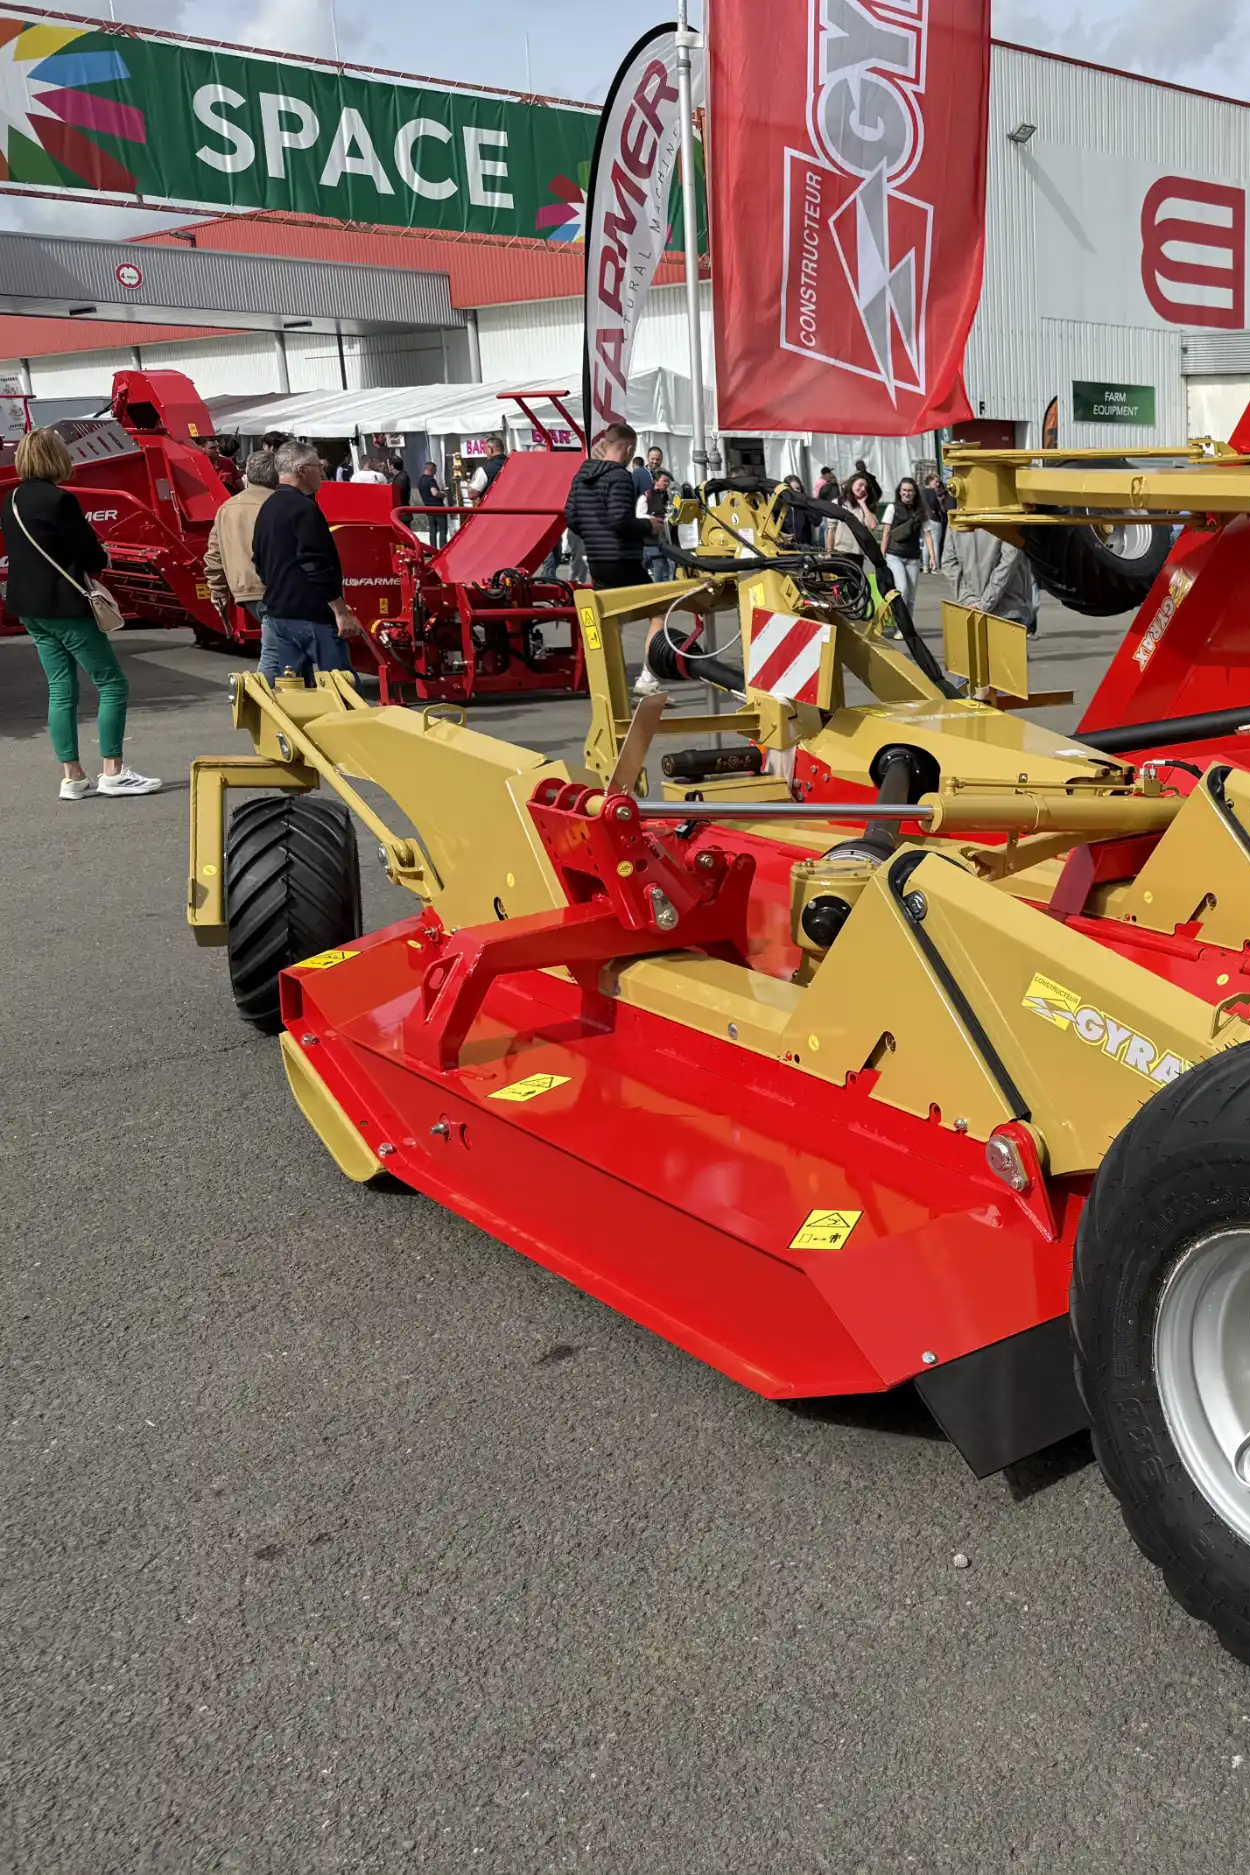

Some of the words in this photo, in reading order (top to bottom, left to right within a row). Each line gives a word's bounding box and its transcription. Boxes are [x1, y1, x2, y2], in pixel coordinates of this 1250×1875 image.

[816, 0, 923, 178] GY
[192, 84, 515, 209] SPACE
[591, 59, 680, 446] FARMER
[800, 171, 822, 347] CONSTRUCTEUR
[624, 251, 652, 342] TURAL
[1093, 404, 1139, 417] EQUIPMENT
[1104, 391, 1126, 402] FARM
[1132, 595, 1177, 673] GYRAX
[1034, 975, 1080, 1005] CONSTRUCTEUR
[1073, 1004, 1194, 1088] GYRA
